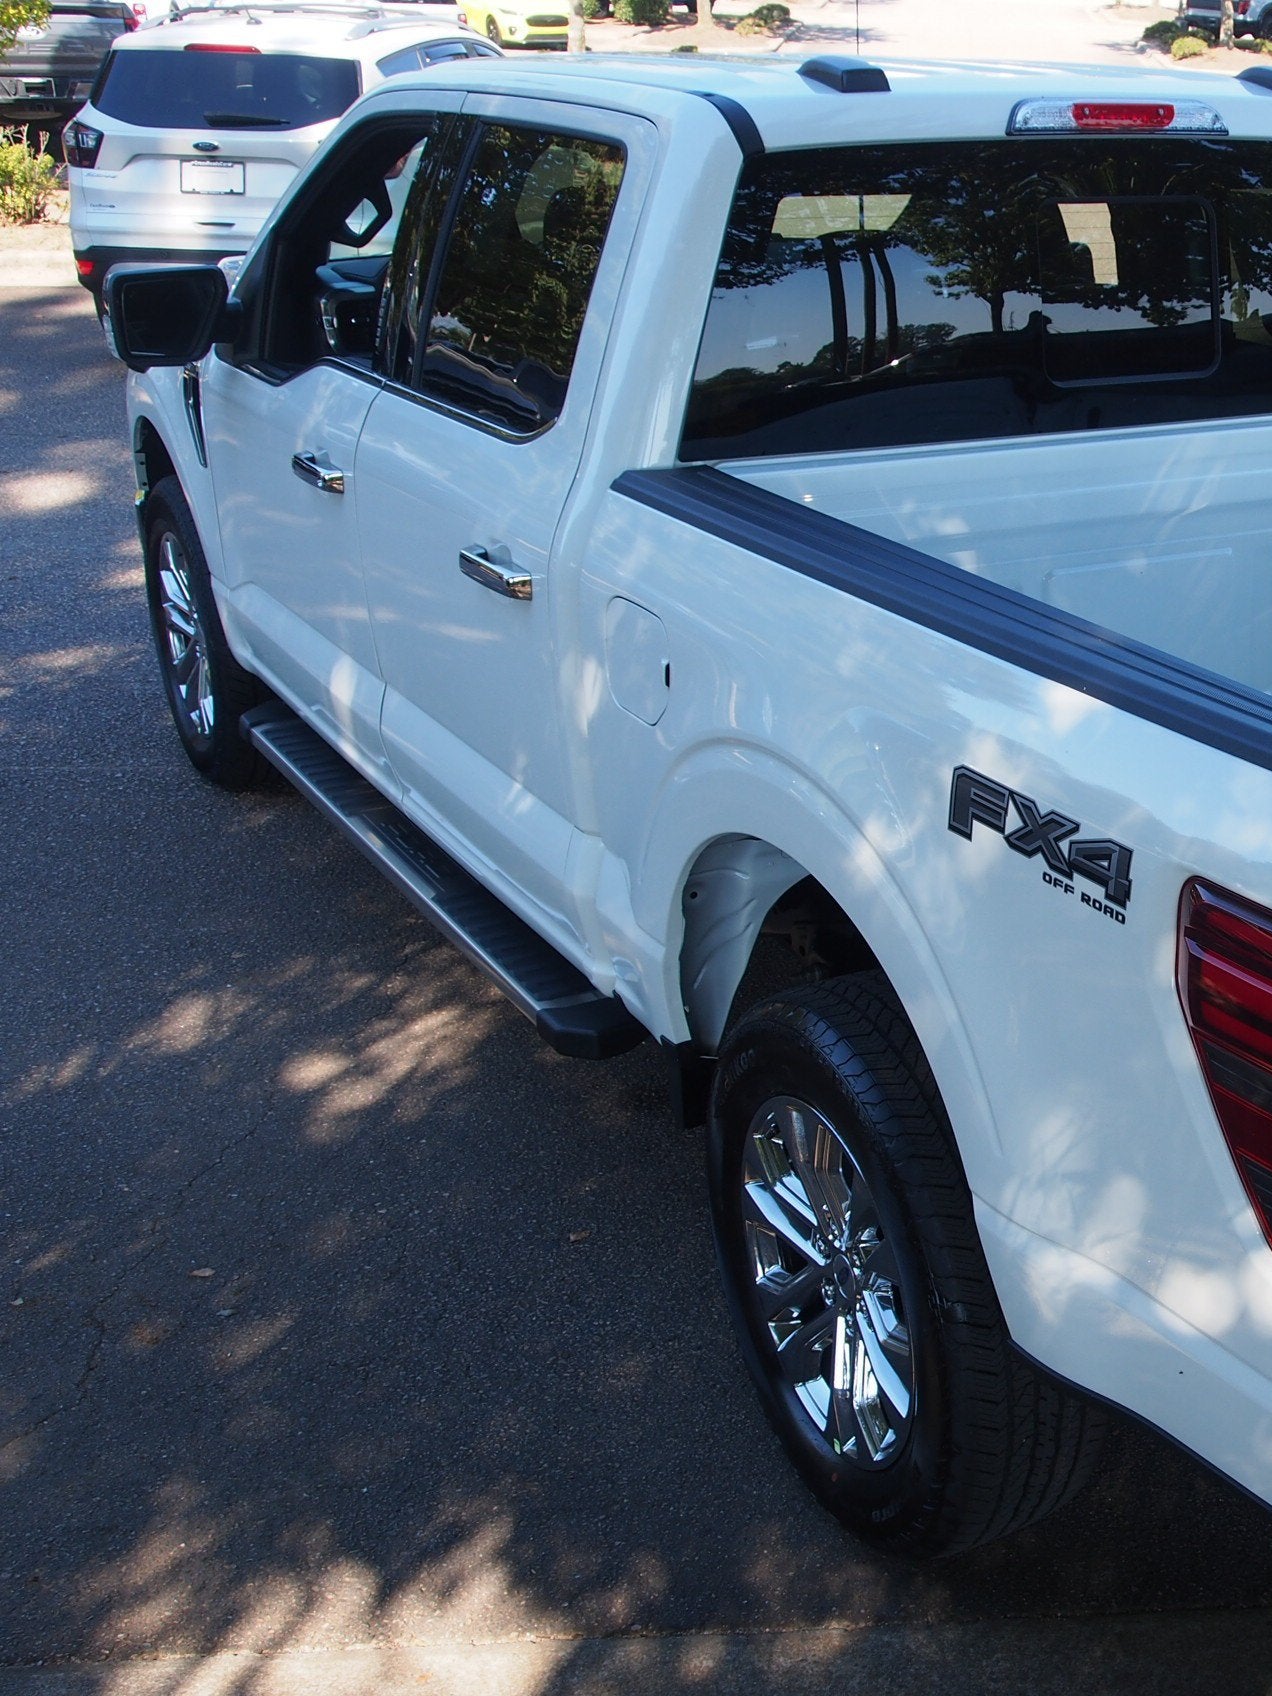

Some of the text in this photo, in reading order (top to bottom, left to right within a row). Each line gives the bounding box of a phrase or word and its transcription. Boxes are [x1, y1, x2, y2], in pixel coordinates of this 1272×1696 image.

[948, 764, 1134, 910] FX4
[1042, 871, 1126, 925] OFF ROAD
